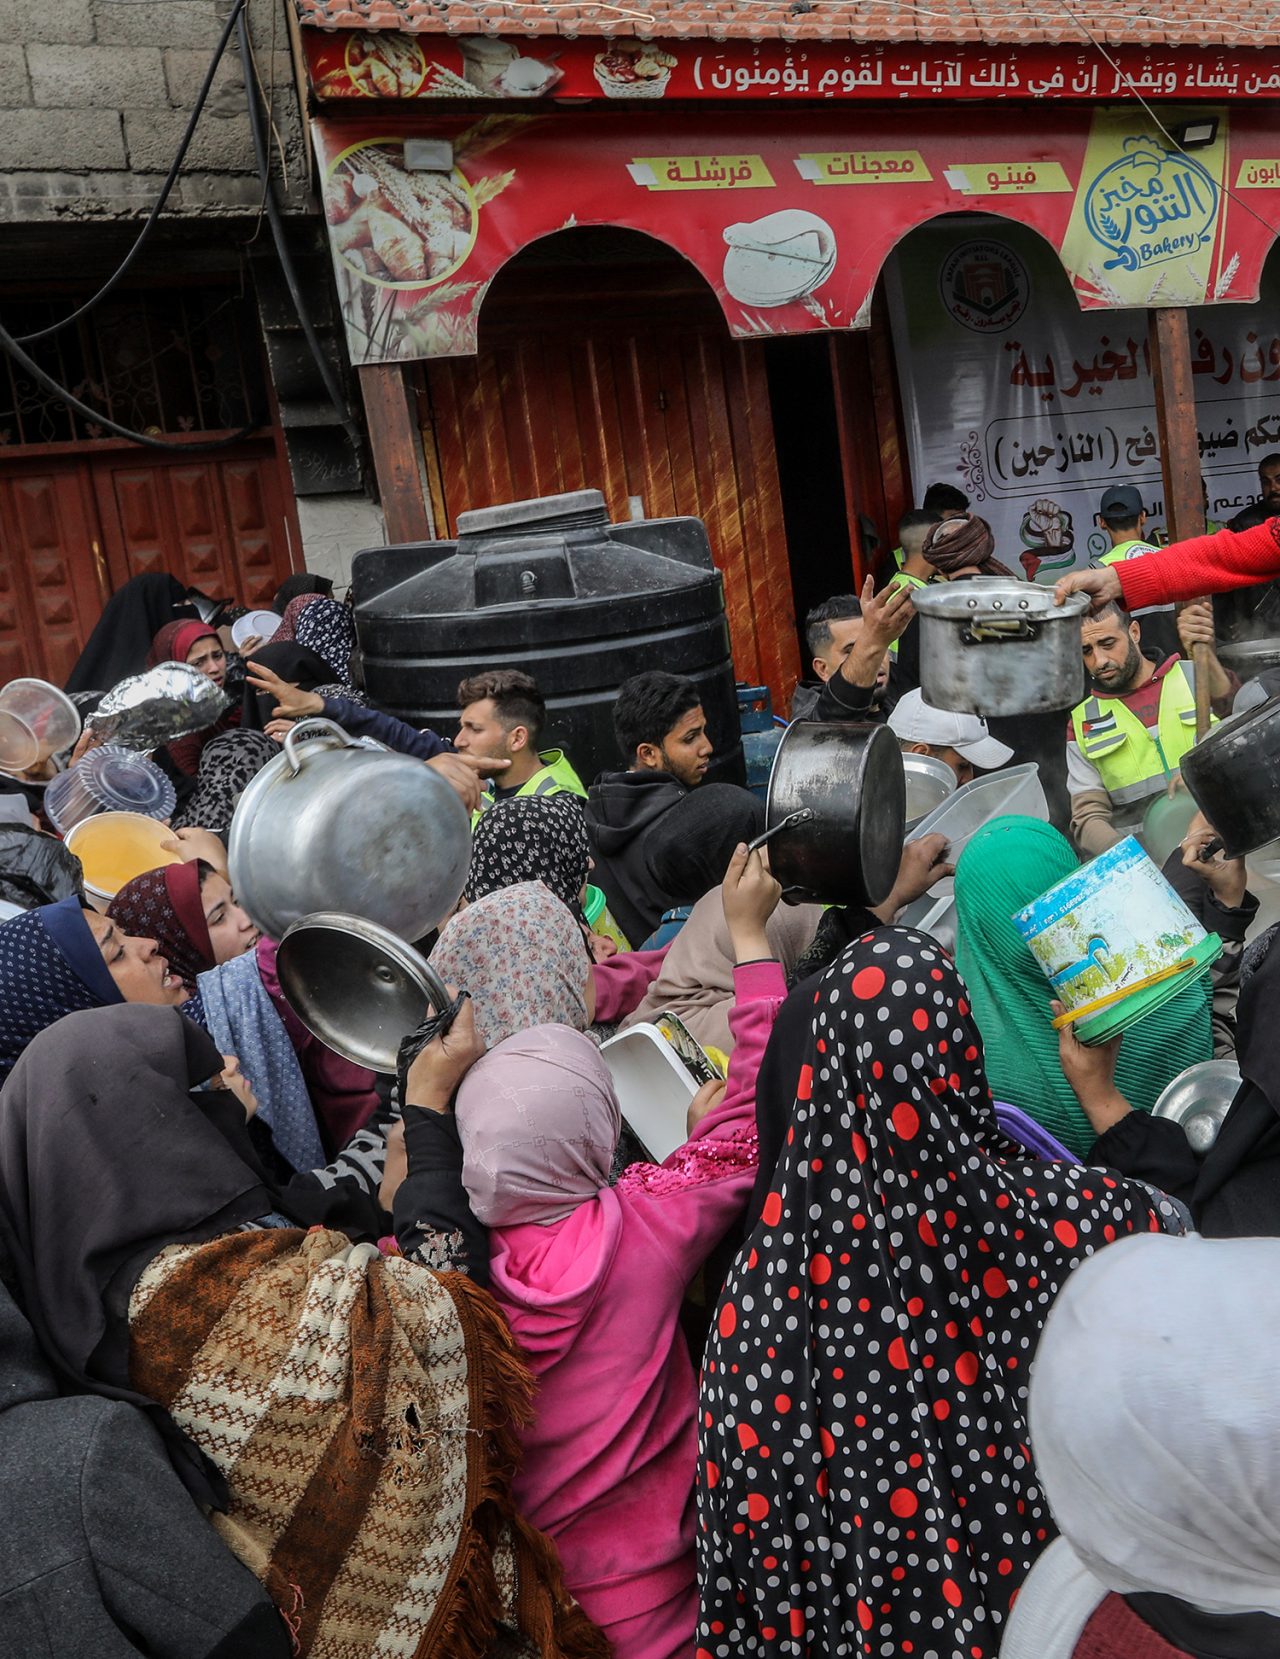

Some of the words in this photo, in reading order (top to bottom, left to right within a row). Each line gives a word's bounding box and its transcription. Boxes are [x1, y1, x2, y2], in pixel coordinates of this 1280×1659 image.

[667, 157, 752, 187] قرشلة
[827, 155, 915, 180] معجنات
[986, 165, 1037, 190] فينو
[1100, 176, 1163, 212] مخبز
[1120, 172, 1206, 244] التنور
[1139, 232, 1195, 261] Bakery
[1004, 334, 1152, 402] الخيرية
[1192, 328, 1233, 385] رف
[1125, 425, 1160, 468] فح
